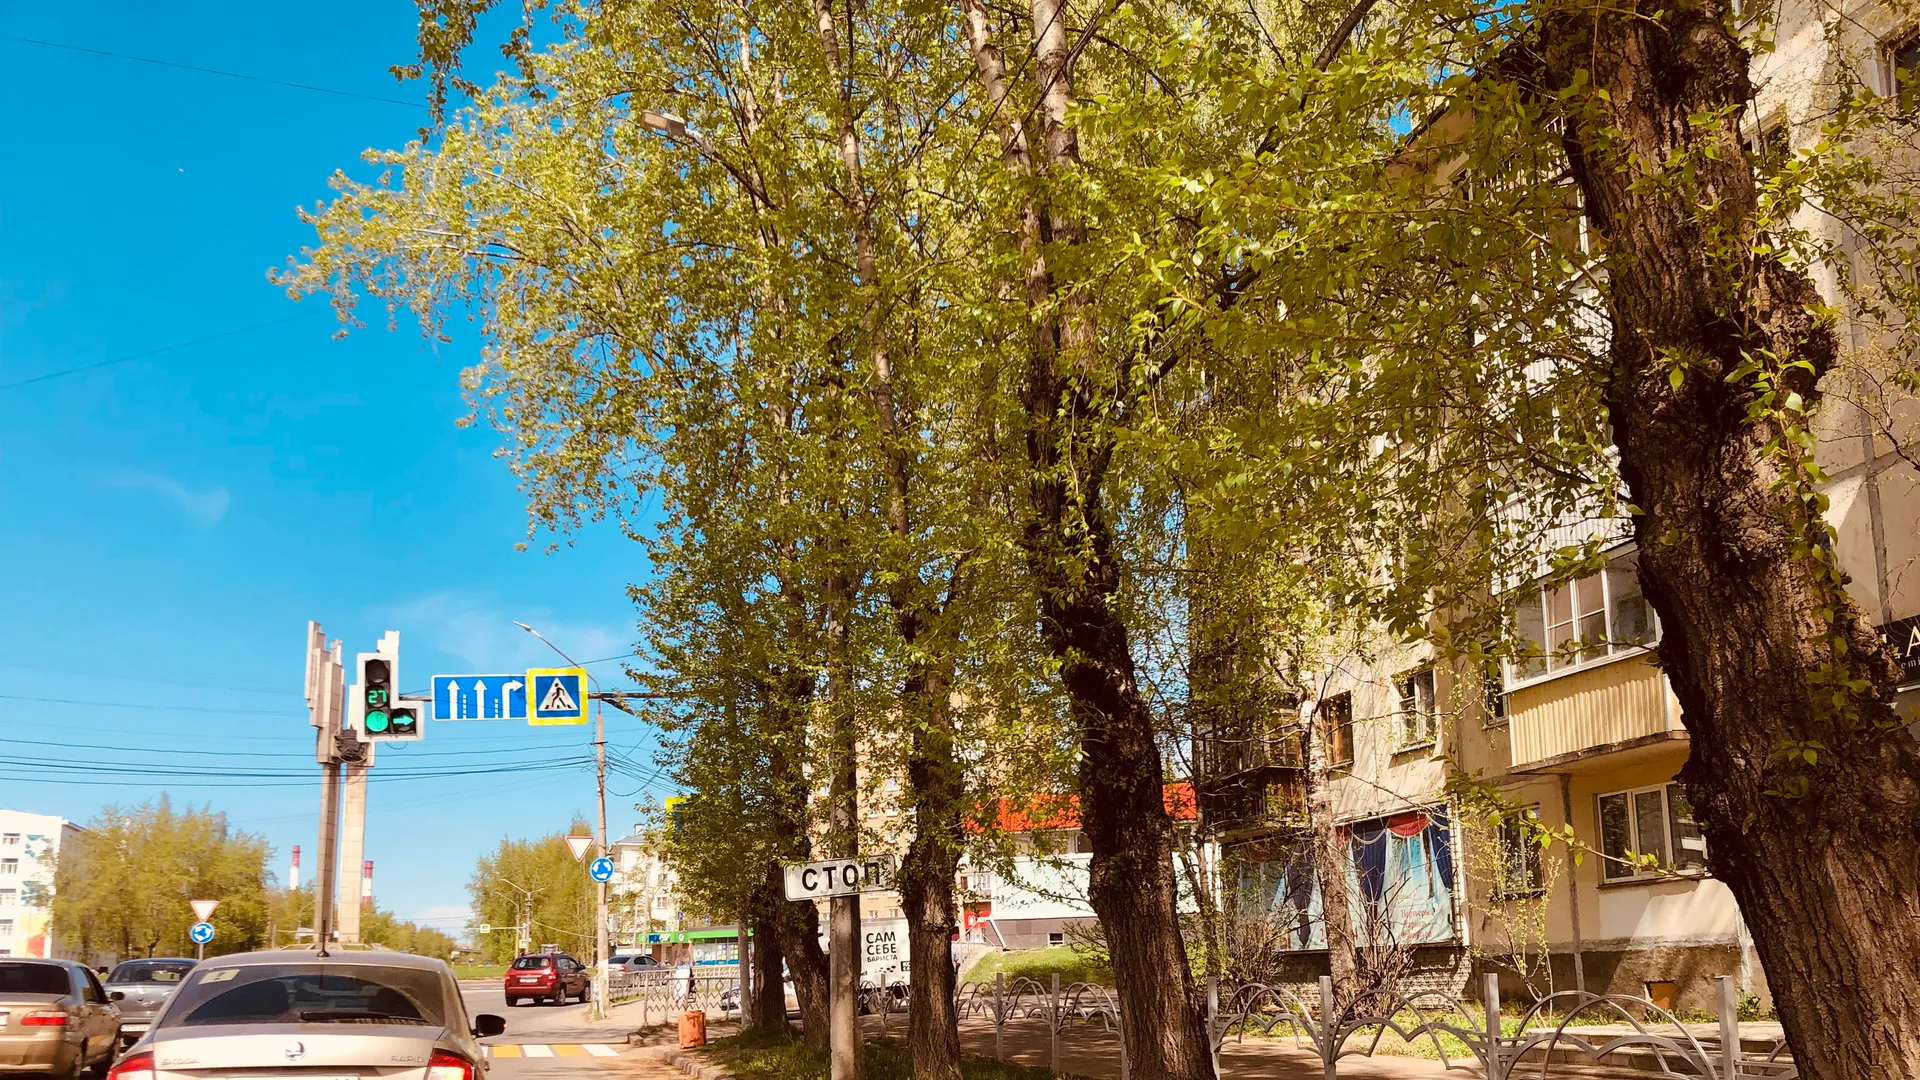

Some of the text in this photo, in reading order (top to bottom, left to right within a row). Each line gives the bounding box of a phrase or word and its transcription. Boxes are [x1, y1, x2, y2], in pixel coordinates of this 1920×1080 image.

[368, 690, 388, 704] 27
[801, 861, 881, 892] СТОП
[865, 930, 896, 944] САМ
[866, 943, 897, 956] СЕБЕ
[867, 954, 898, 963] БАРИСТА
[390, 1054, 424, 1063] RAPID
